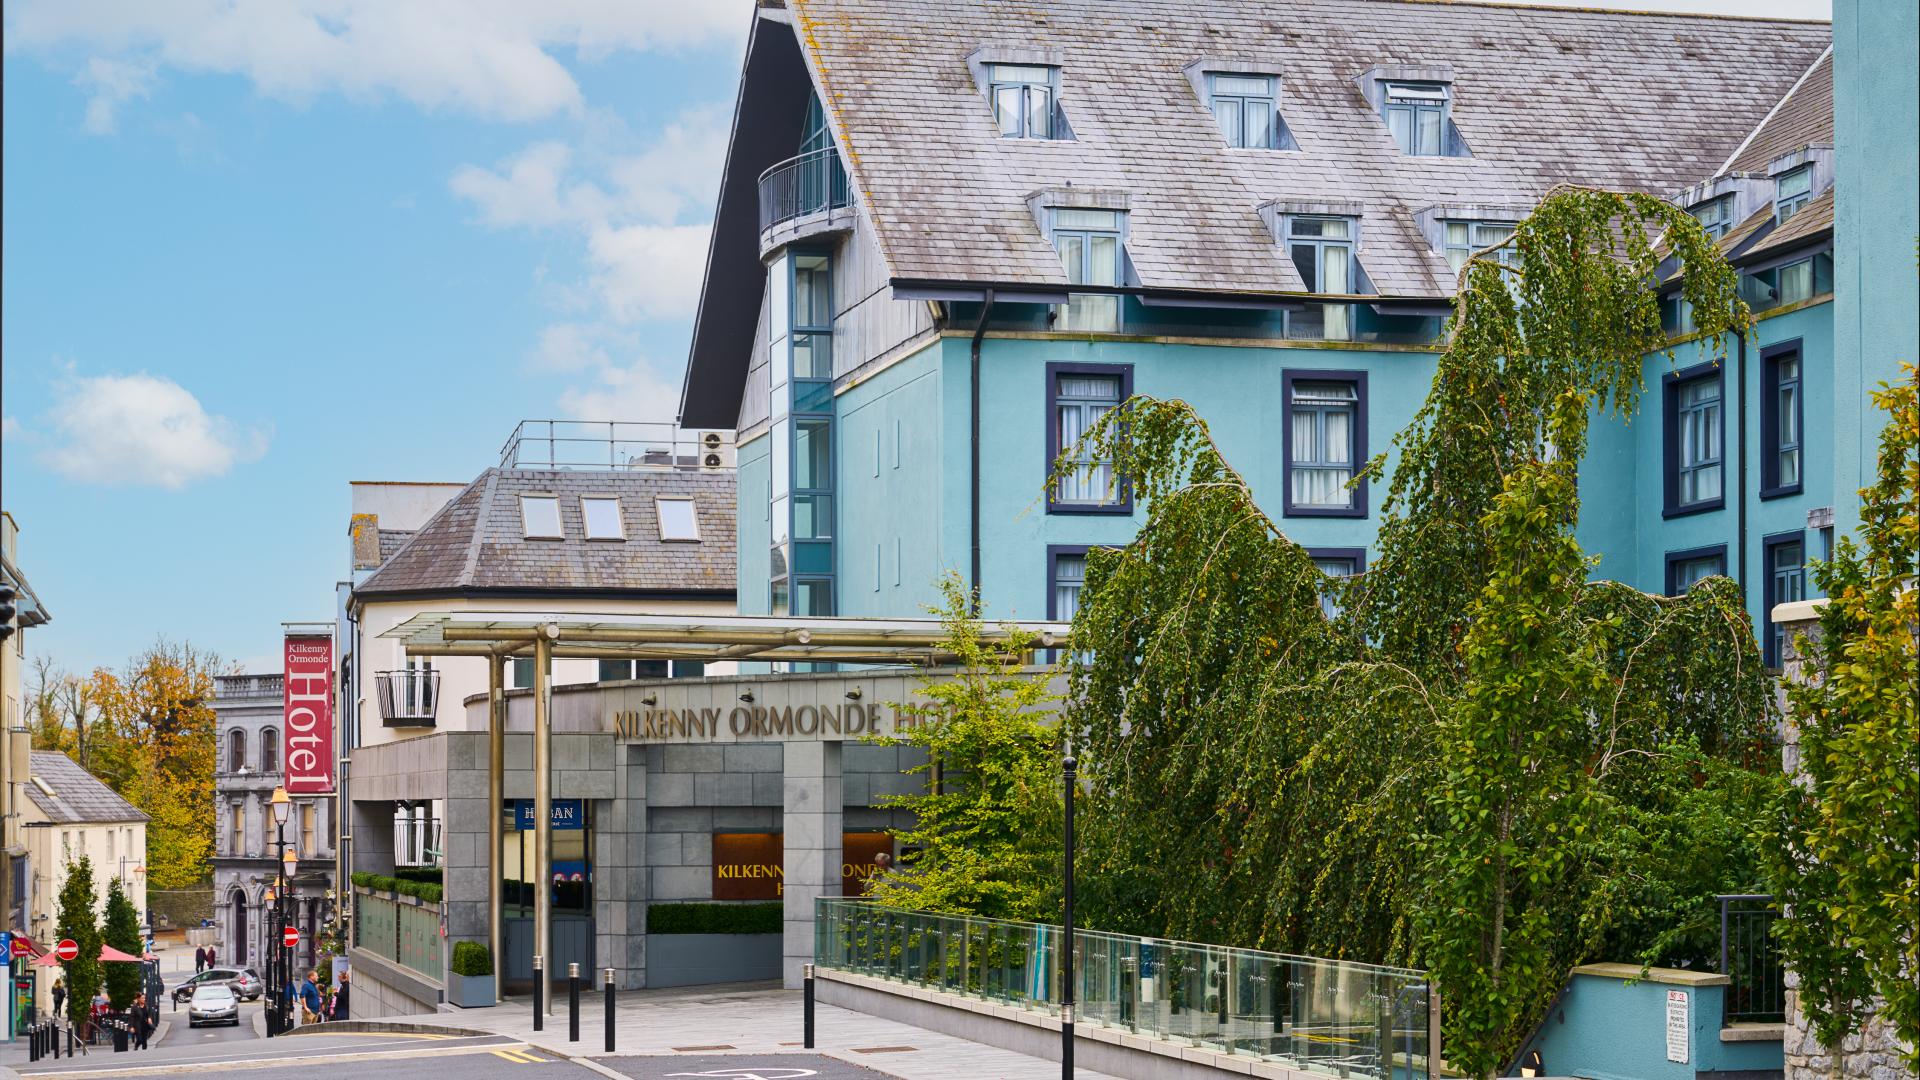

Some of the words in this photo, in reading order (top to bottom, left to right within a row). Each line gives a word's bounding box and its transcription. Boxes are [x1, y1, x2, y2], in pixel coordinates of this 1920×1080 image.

[288, 644, 329, 654] Kilkenny
[288, 655, 329, 663] Ormonde
[288, 667, 329, 786] Hotel
[613, 707, 721, 739] KILKENNY
[729, 703, 881, 736] ORMONDE
[718, 864, 784, 878] KILKENN
